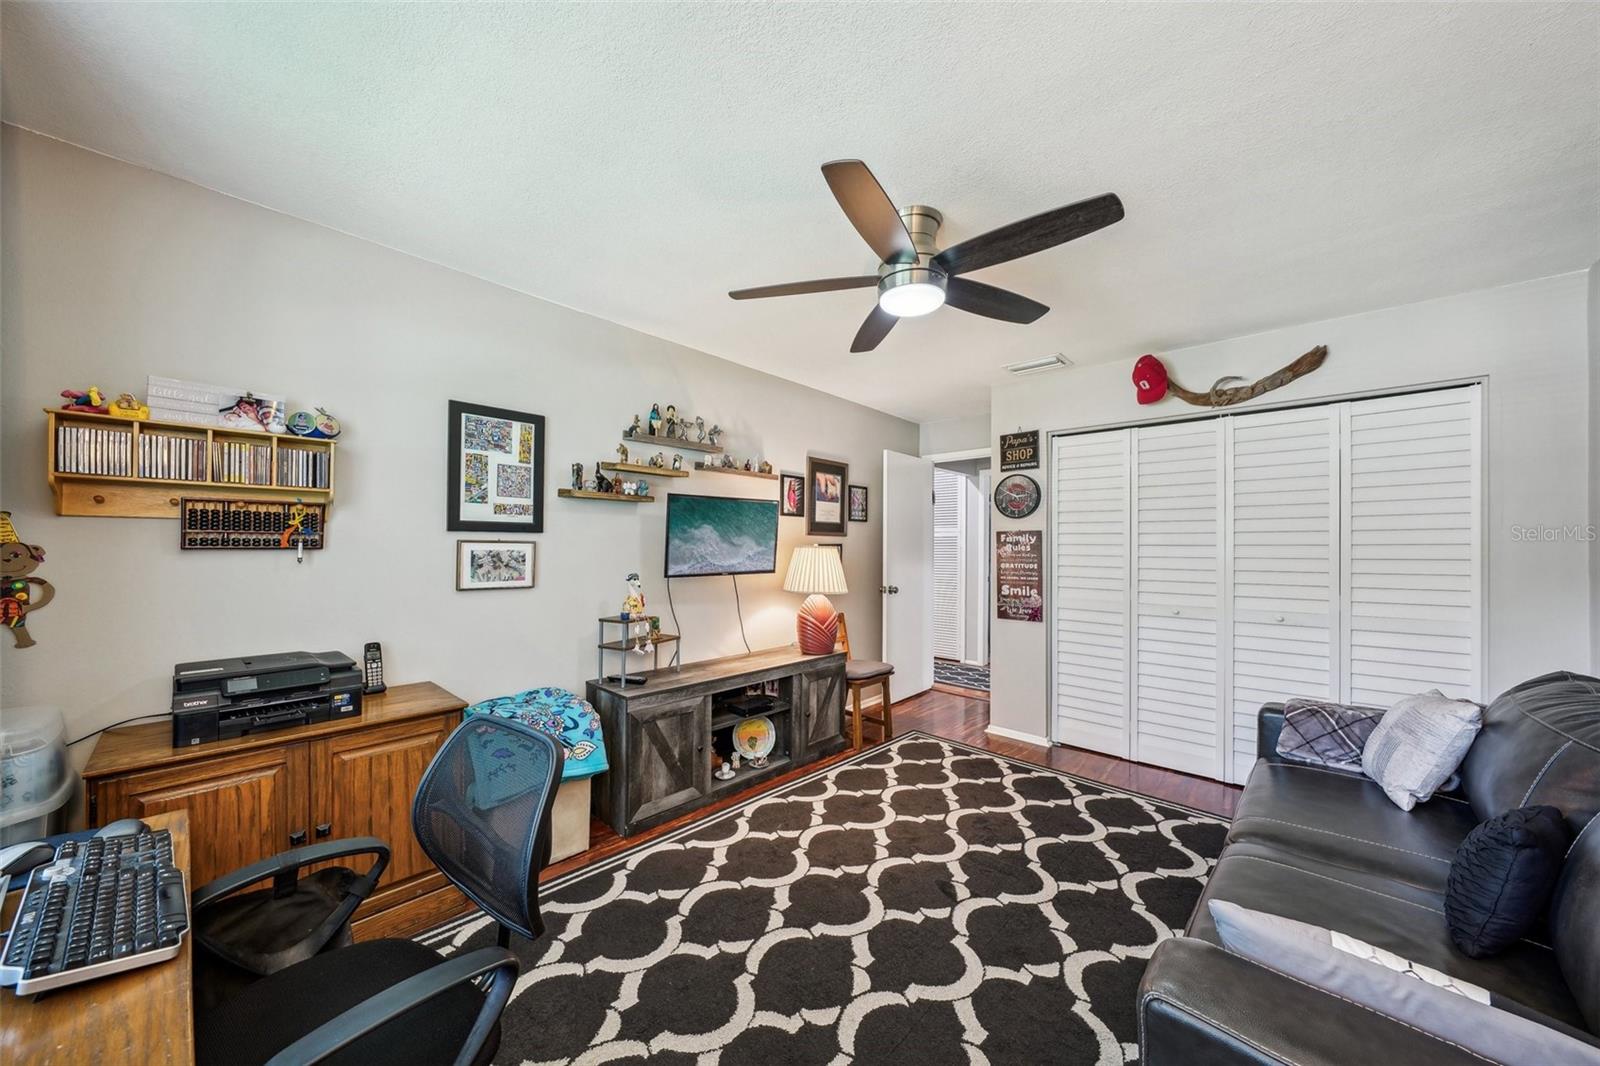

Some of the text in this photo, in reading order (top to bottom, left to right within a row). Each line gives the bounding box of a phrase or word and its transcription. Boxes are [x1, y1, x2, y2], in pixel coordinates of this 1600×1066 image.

[1004, 434, 1034, 448] Papa's
[1006, 448, 1033, 461] SHOP
[1000, 533, 1037, 545] Family
[1006, 543, 1031, 552] Rules
[1001, 584, 1038, 597] Smile
[183, 700, 208, 708] brother
